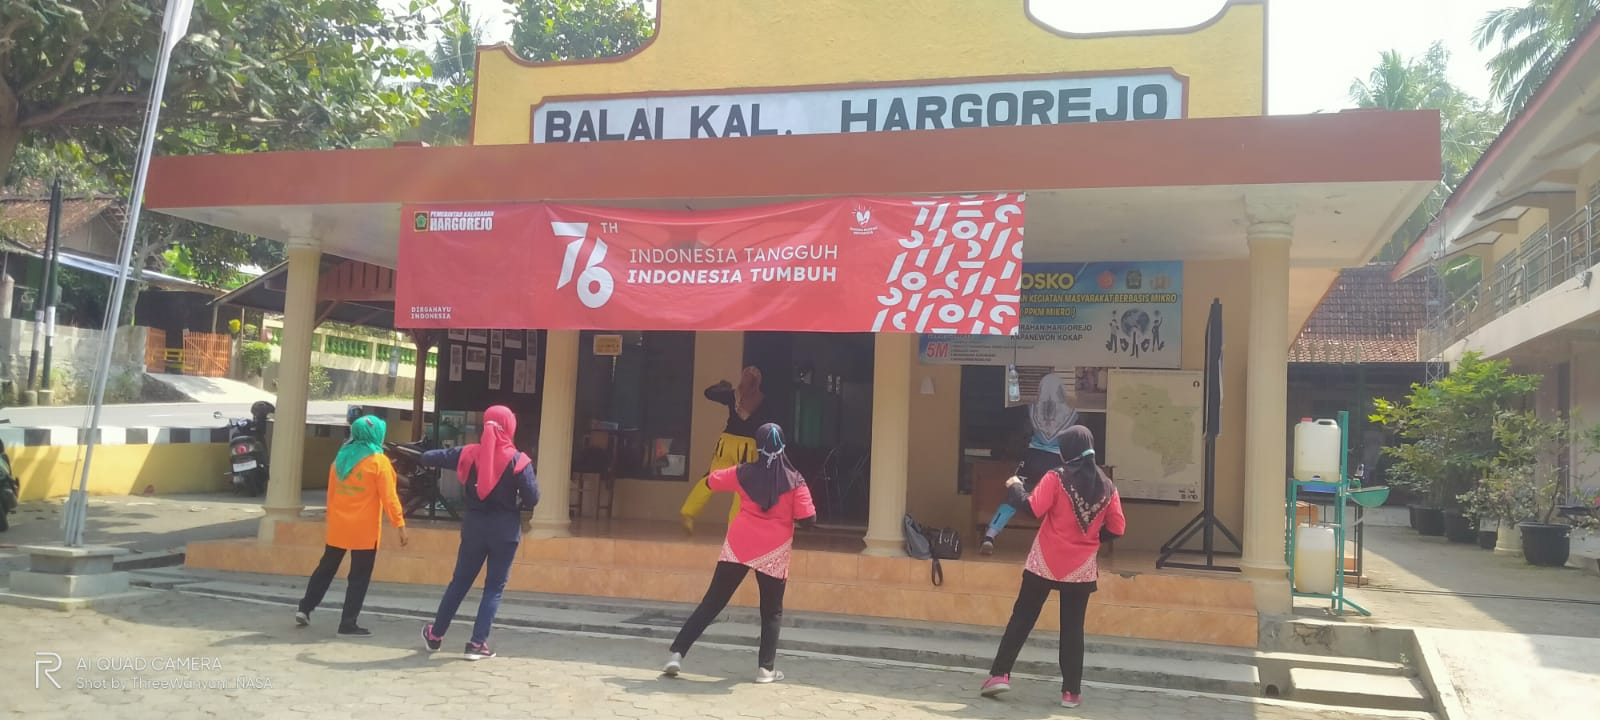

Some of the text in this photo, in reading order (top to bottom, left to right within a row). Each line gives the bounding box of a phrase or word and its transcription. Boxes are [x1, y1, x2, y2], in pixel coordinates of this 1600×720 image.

[545, 83, 1168, 143] BALAI KAL. HARGOREJO
[429, 217, 493, 231] HARGOREJO
[630, 244, 838, 264] INDONESIA TANGGUH
[551, 221, 615, 309] 76
[600, 222, 619, 234] TH
[627, 267, 837, 284] INDONESIA TUMBUH
[1021, 273, 1074, 289] OSKO
[1029, 294, 1063, 303] KEGIATAN
[1064, 294, 1113, 303] MASYARAKAT
[1114, 293, 1149, 303] BERBASIS
[1151, 294, 1177, 302] MIKRO
[1023, 307, 1045, 316] PPKM
[927, 342, 949, 358] 5M
